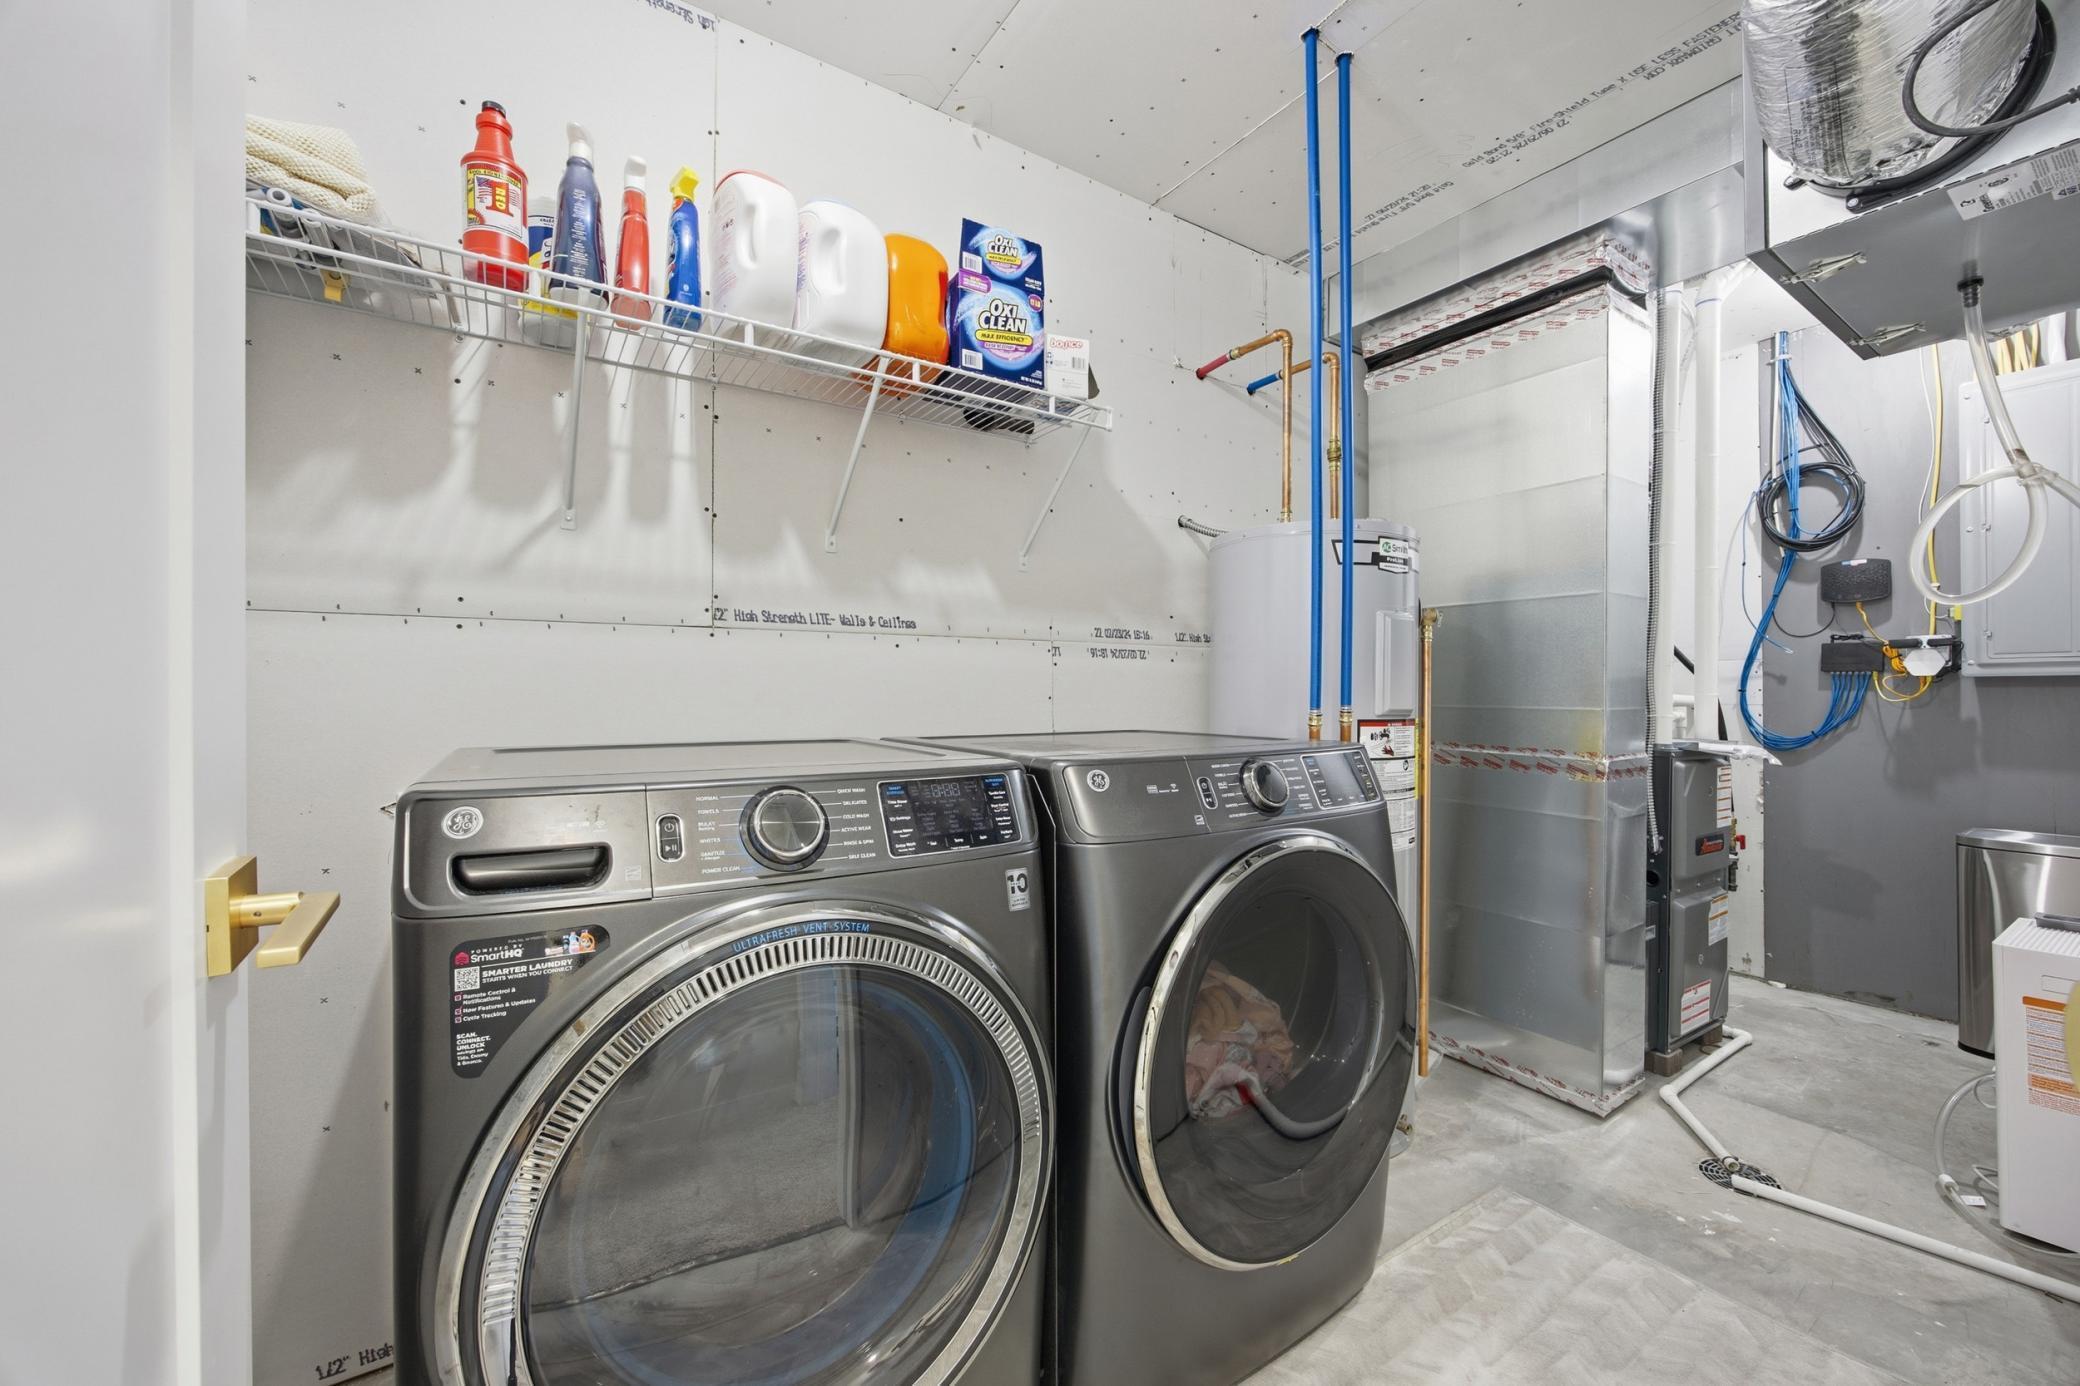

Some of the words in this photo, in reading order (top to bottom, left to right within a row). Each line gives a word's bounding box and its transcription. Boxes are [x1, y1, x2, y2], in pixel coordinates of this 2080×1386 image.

[495, 186, 507, 210] RED
[988, 241, 1018, 257] CLEAN
[995, 235, 1013, 247] OXI
[989, 299, 1019, 318] OXI
[979, 310, 1027, 333] CLEAN
[733, 925, 797, 952] ULTRAFRESH
[803, 921, 828, 934] VENT
[834, 921, 870, 932] SYSTEM
[470, 948, 524, 963] SmartHQ
[482, 965, 527, 978] SMARTER
[529, 958, 573, 971] LAUNDRY
[482, 975, 506, 984] STARTS
